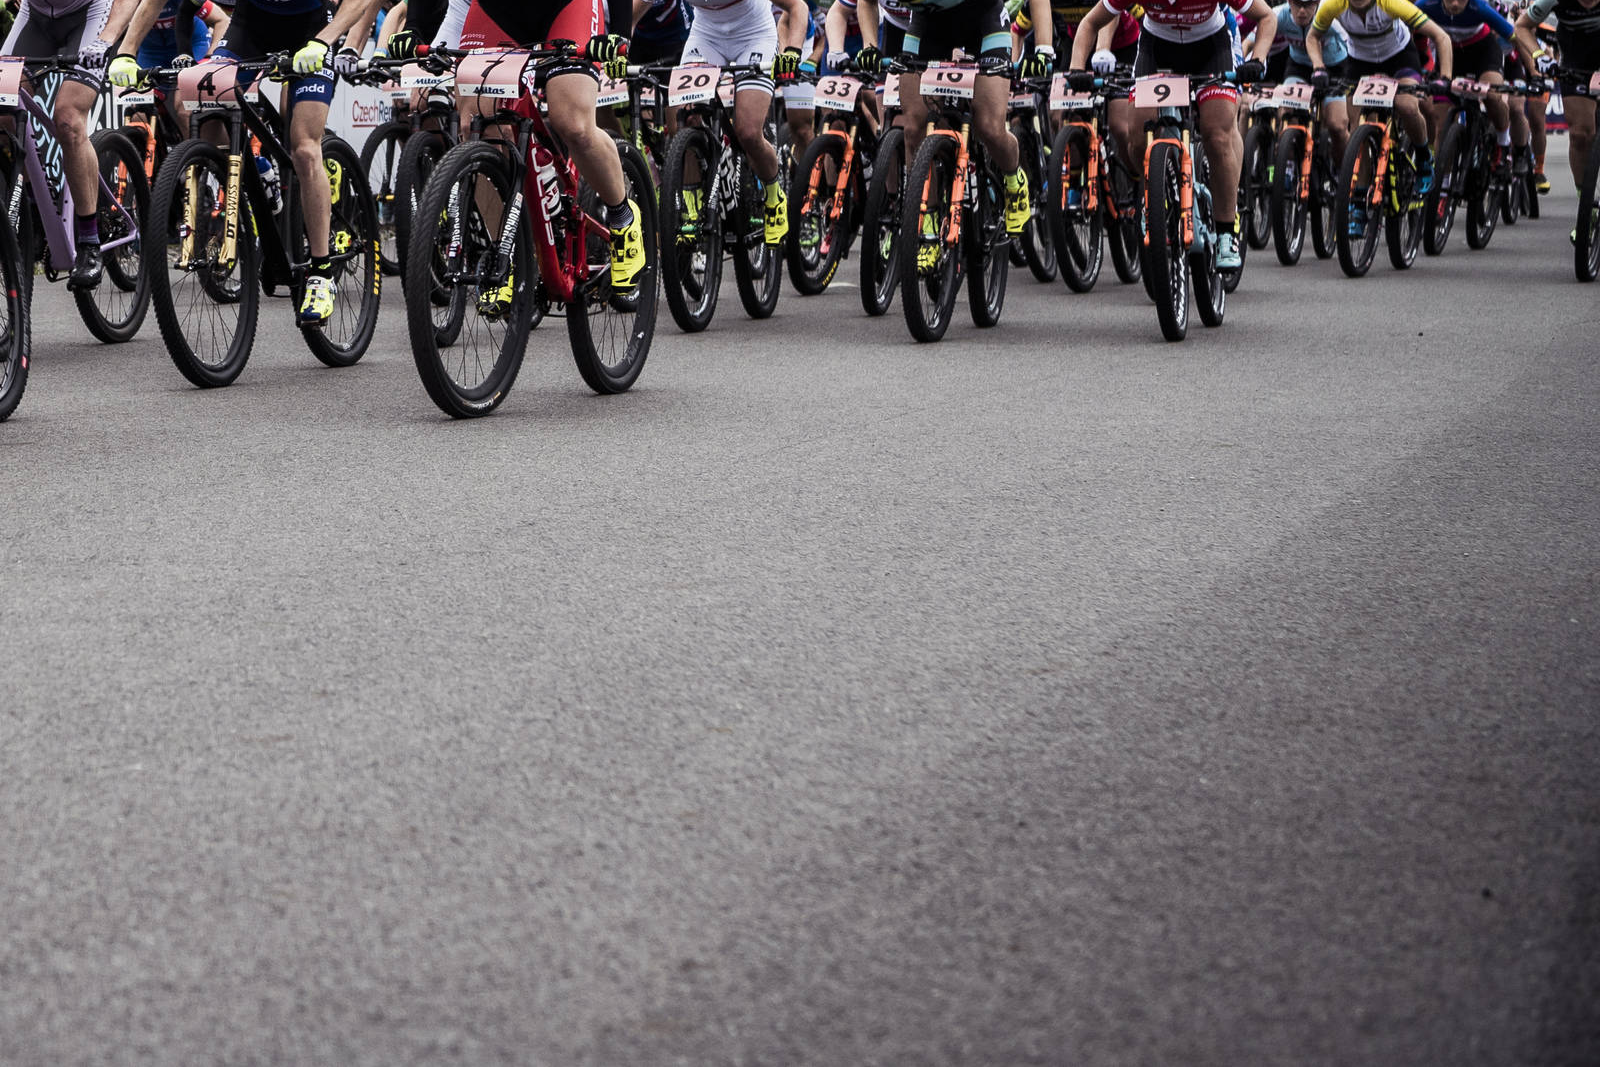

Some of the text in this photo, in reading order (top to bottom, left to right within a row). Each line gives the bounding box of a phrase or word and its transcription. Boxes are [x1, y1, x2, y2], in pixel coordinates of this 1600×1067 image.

[197, 72, 216, 96] 4
[677, 74, 710, 90] 20
[823, 80, 851, 97] 33
[1363, 83, 1388, 96] 23
[680, 93, 704, 102] Mitas
[932, 87, 961, 95] Mitas
[1153, 84, 1171, 103] 9
[1283, 86, 1303, 98] 31
[500, 206, 521, 256] ROCKSHOX
